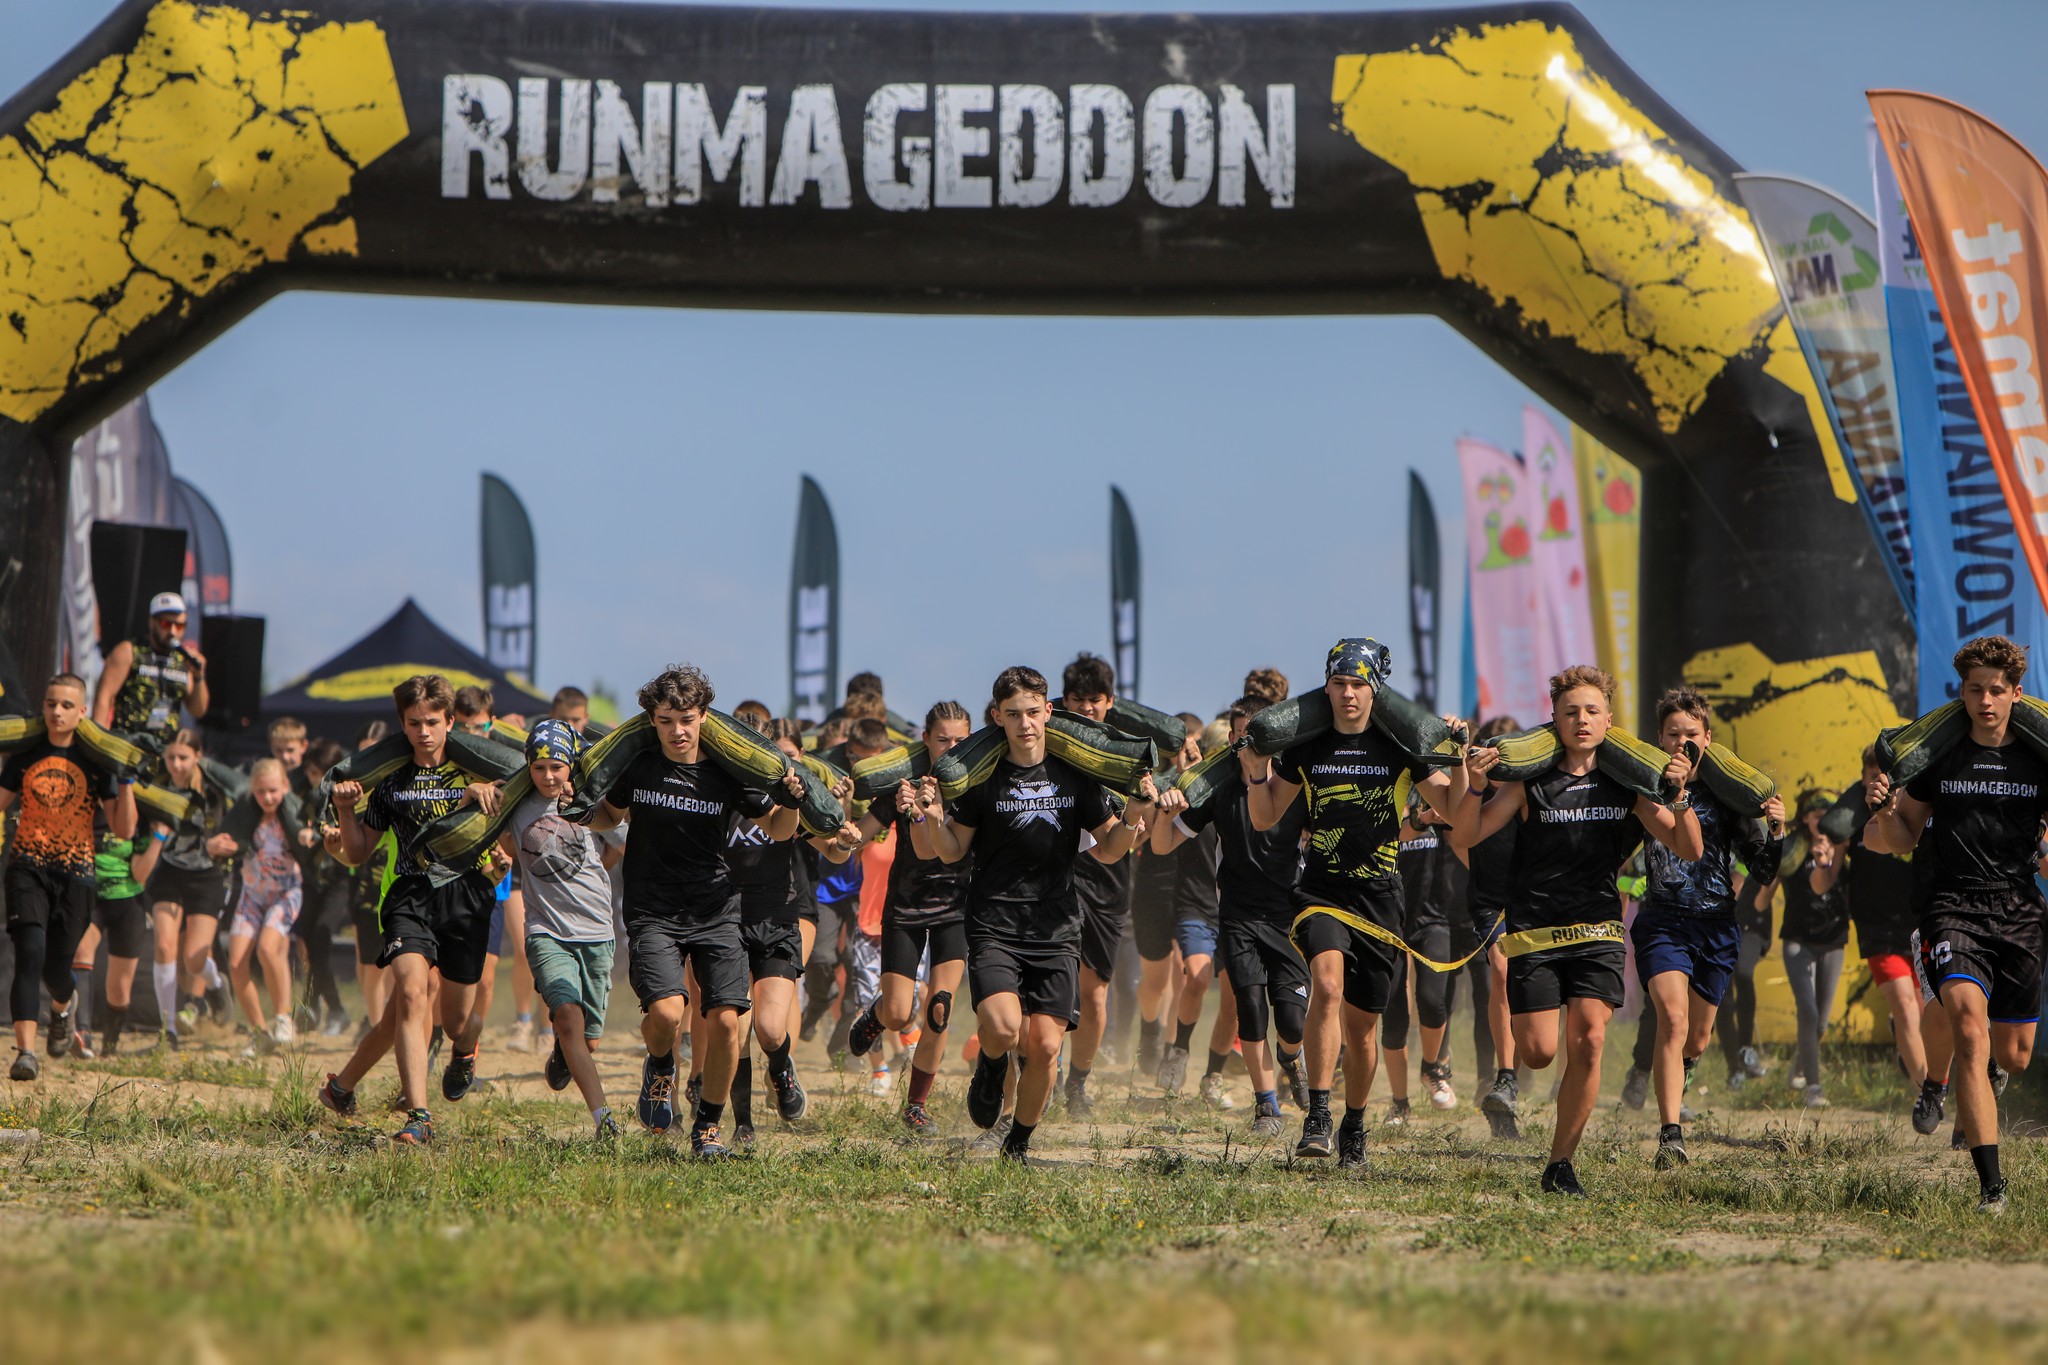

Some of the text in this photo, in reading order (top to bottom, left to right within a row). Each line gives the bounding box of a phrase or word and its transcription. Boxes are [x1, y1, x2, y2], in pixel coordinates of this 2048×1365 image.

[440, 73, 1297, 211] RUNMAGEDDON
[1311, 764, 1390, 776] RUNMAGEDDON
[1972, 763, 2008, 771] SMMASH
[1019, 780, 1050, 788] SMMASH
[1565, 782, 1598, 792] SMMASH
[1940, 780, 2038, 798] RUNMAGEDDON
[393, 788, 465, 801] RUNMAGEDDON
[632, 788, 724, 816] RUNMAGEDDON
[995, 796, 1075, 812] RUNMAGEDDON
[1540, 806, 1628, 823] RUNMAGEDDON
[1400, 837, 1439, 853] AGEDDON
